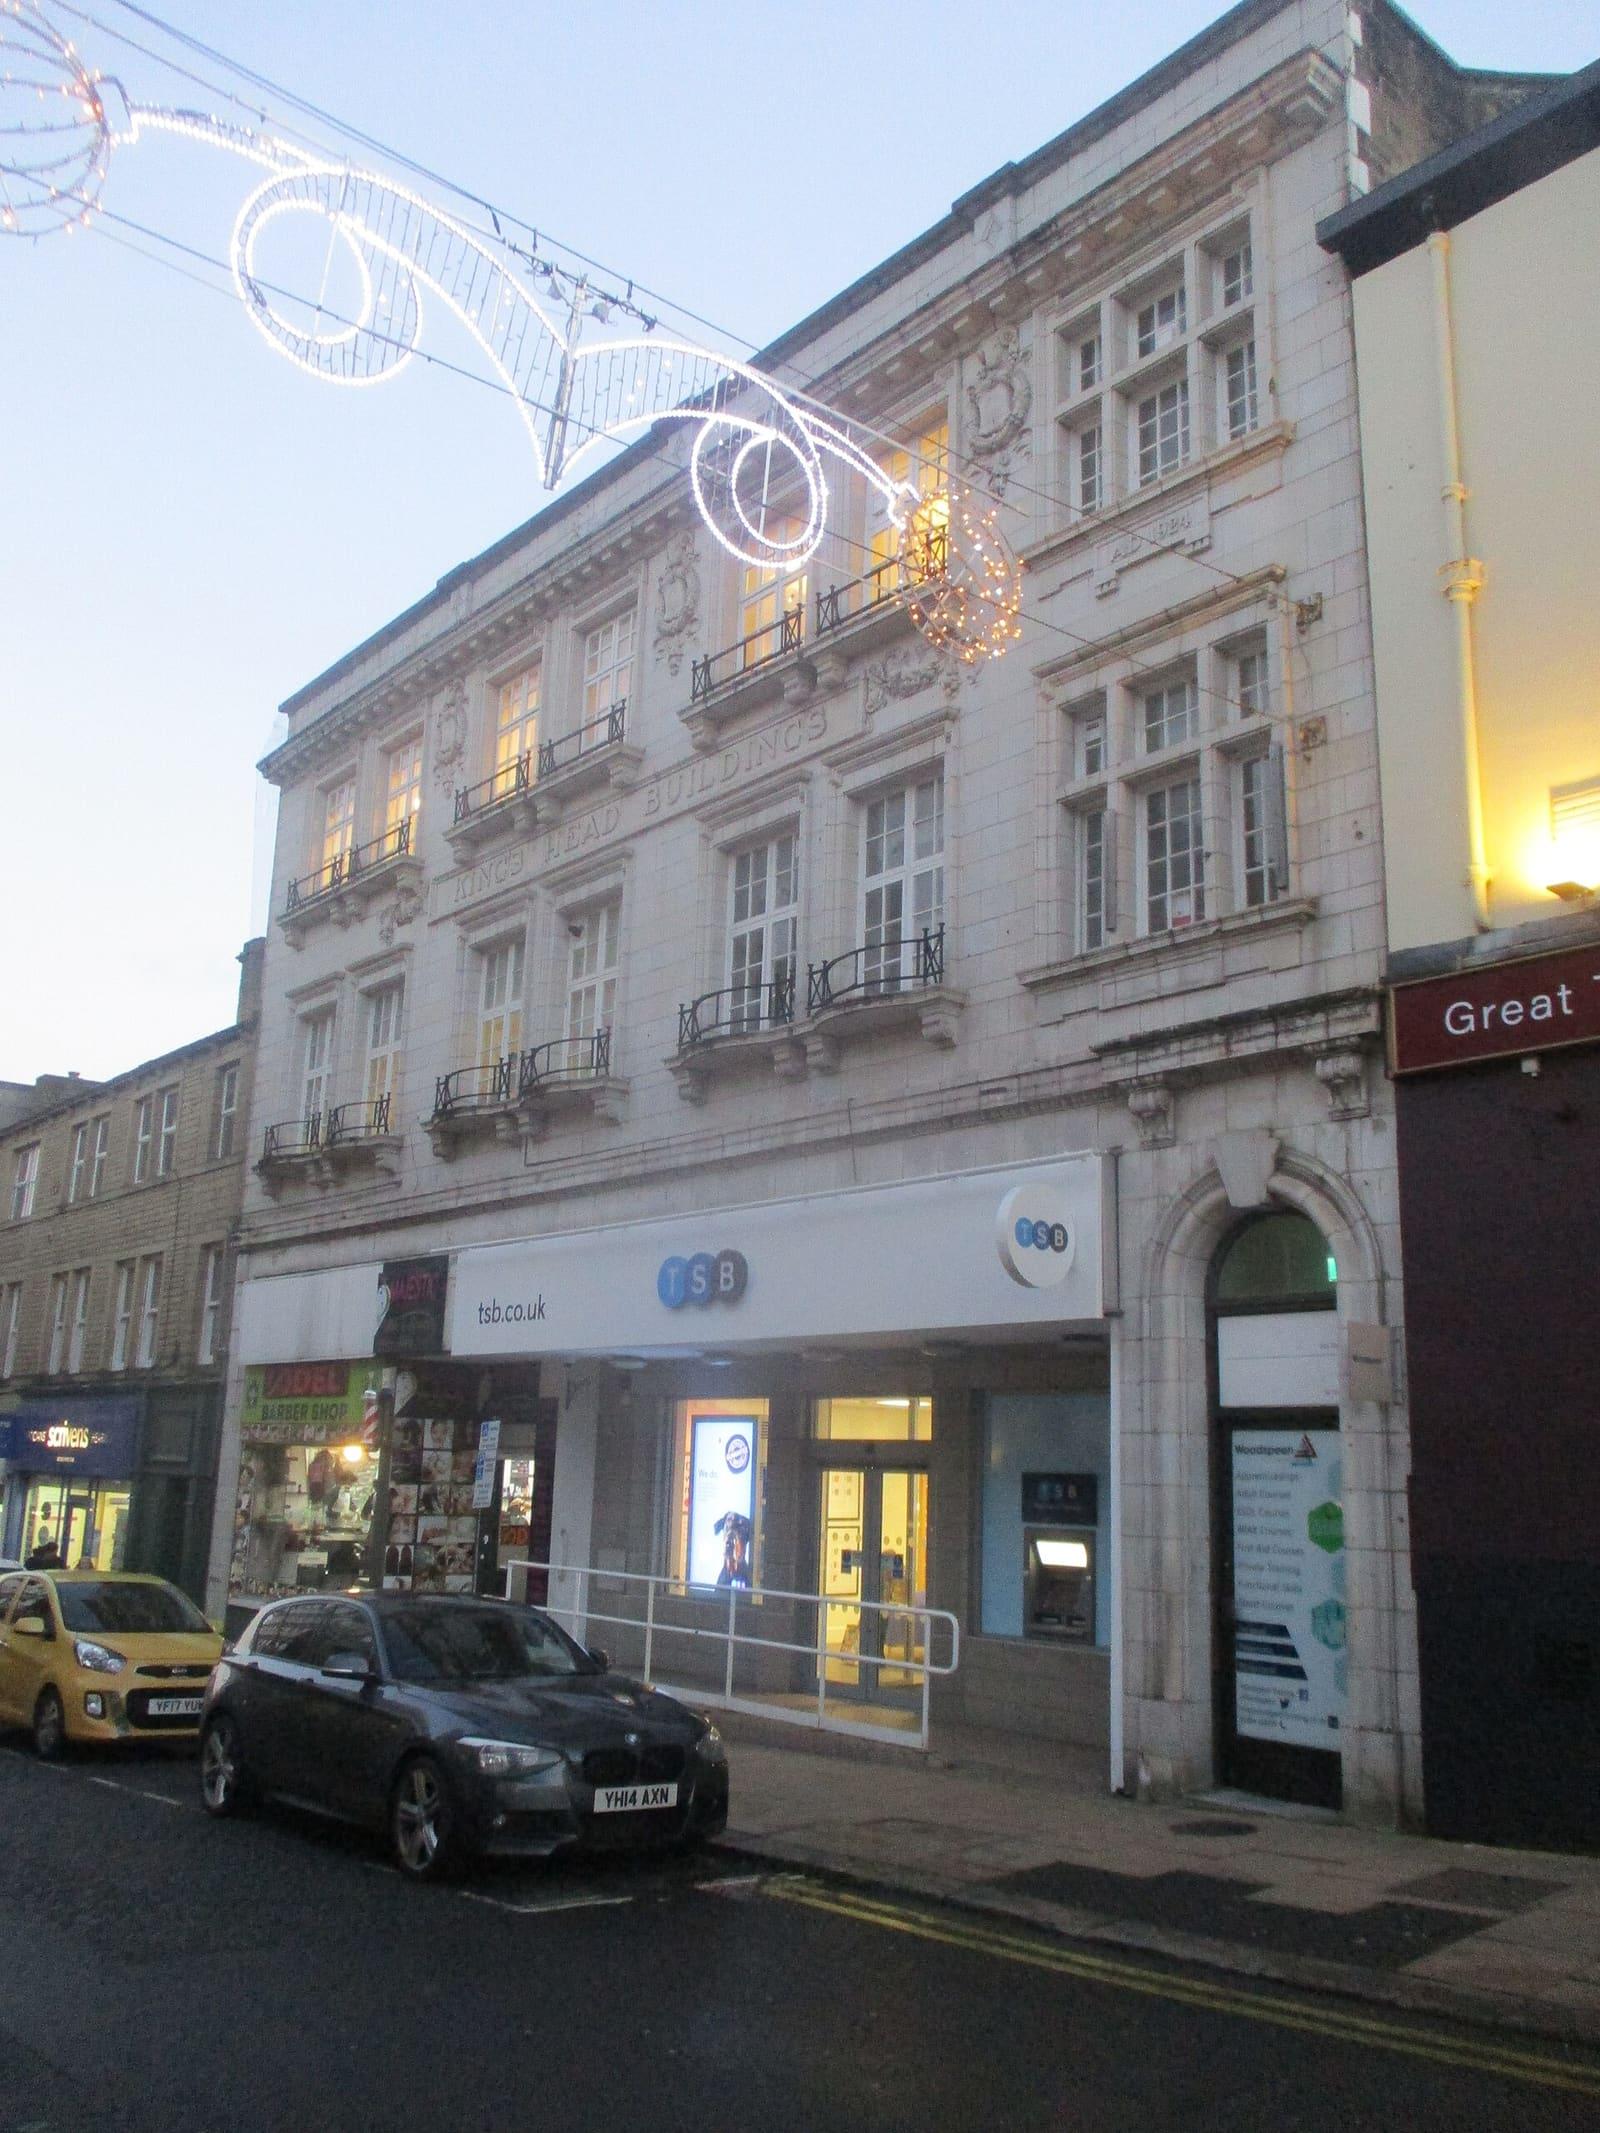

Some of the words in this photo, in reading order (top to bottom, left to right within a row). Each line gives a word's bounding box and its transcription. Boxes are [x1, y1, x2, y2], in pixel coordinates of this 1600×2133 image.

[545, 806, 621, 864] HEAD
[642, 705, 828, 817] BUILDINGS
[1443, 983, 1575, 1036] Great
[1018, 1219, 1066, 1250] TSB
[665, 1257, 737, 1300] TSB
[477, 1293, 547, 1326] tsb.co.uk
[261, 1403, 309, 1421] BARBER
[311, 1403, 348, 1420] SHOP
[155, 1699, 182, 1713] YF17
[604, 1789, 638, 1809] YH14
[640, 1786, 670, 1806] AXN
